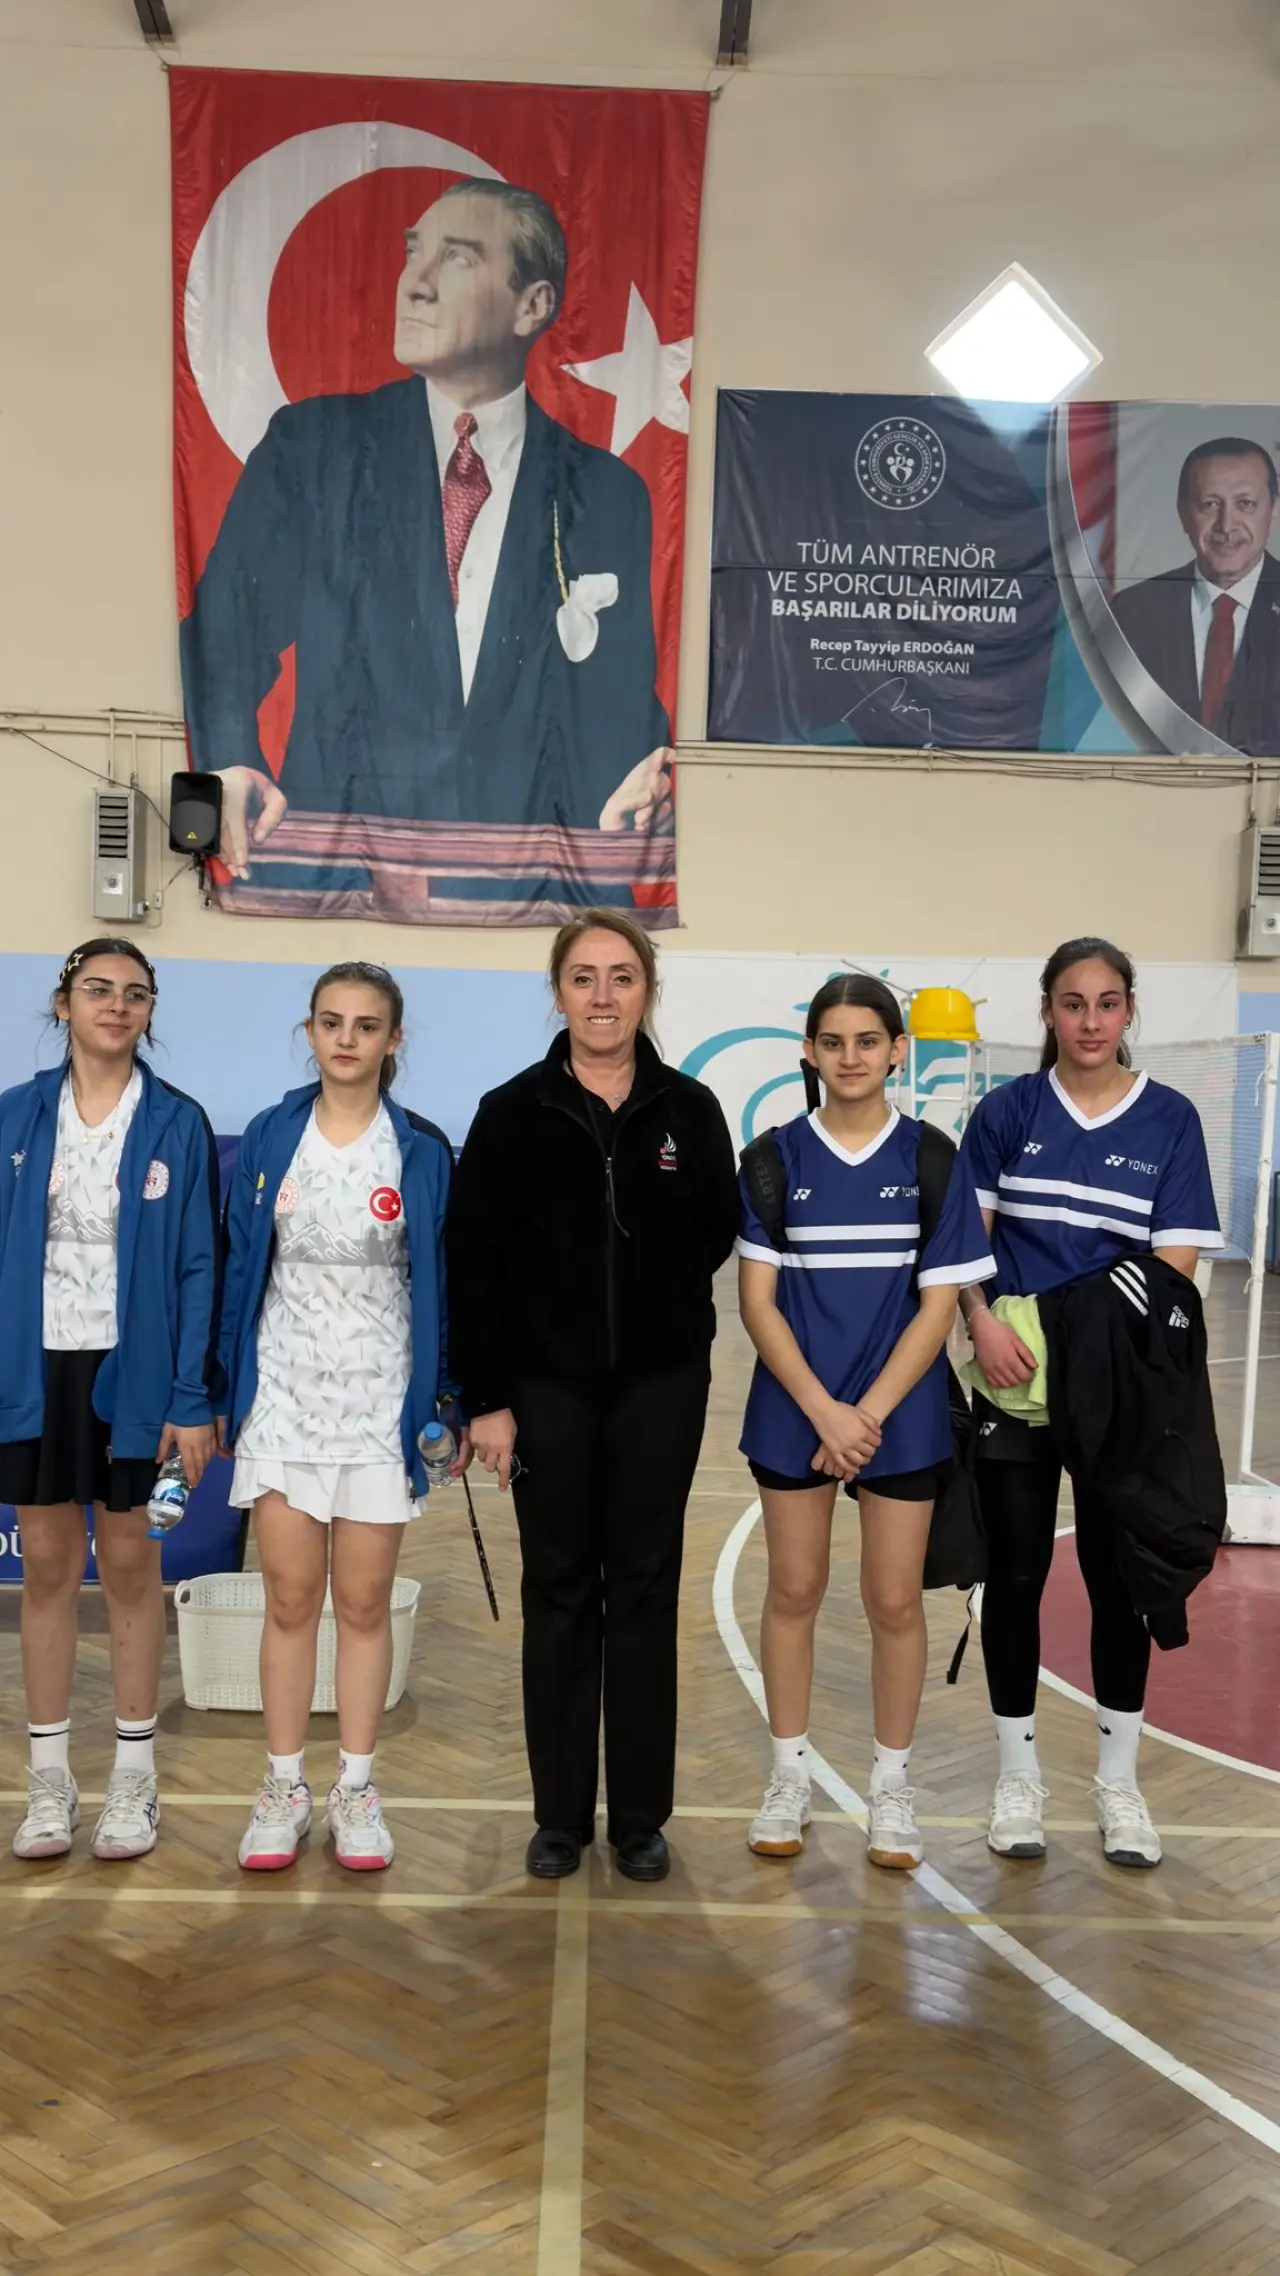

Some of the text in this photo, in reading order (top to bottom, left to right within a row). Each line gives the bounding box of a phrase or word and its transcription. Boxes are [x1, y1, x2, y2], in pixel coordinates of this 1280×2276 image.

[797, 539, 996, 568] TÜM ANTRENÖR
[767, 570, 1022, 599] VE SPORCULARIMIZA
[771, 599, 1017, 623] BAŞARILAR DİLİYORUM
[810, 638, 975, 656] Recep Tayyip ERDOĞAN
[813, 657, 970, 677] T.C. CUMHURBAŞKANI
[1128, 1158, 1159, 1175] YONEX
